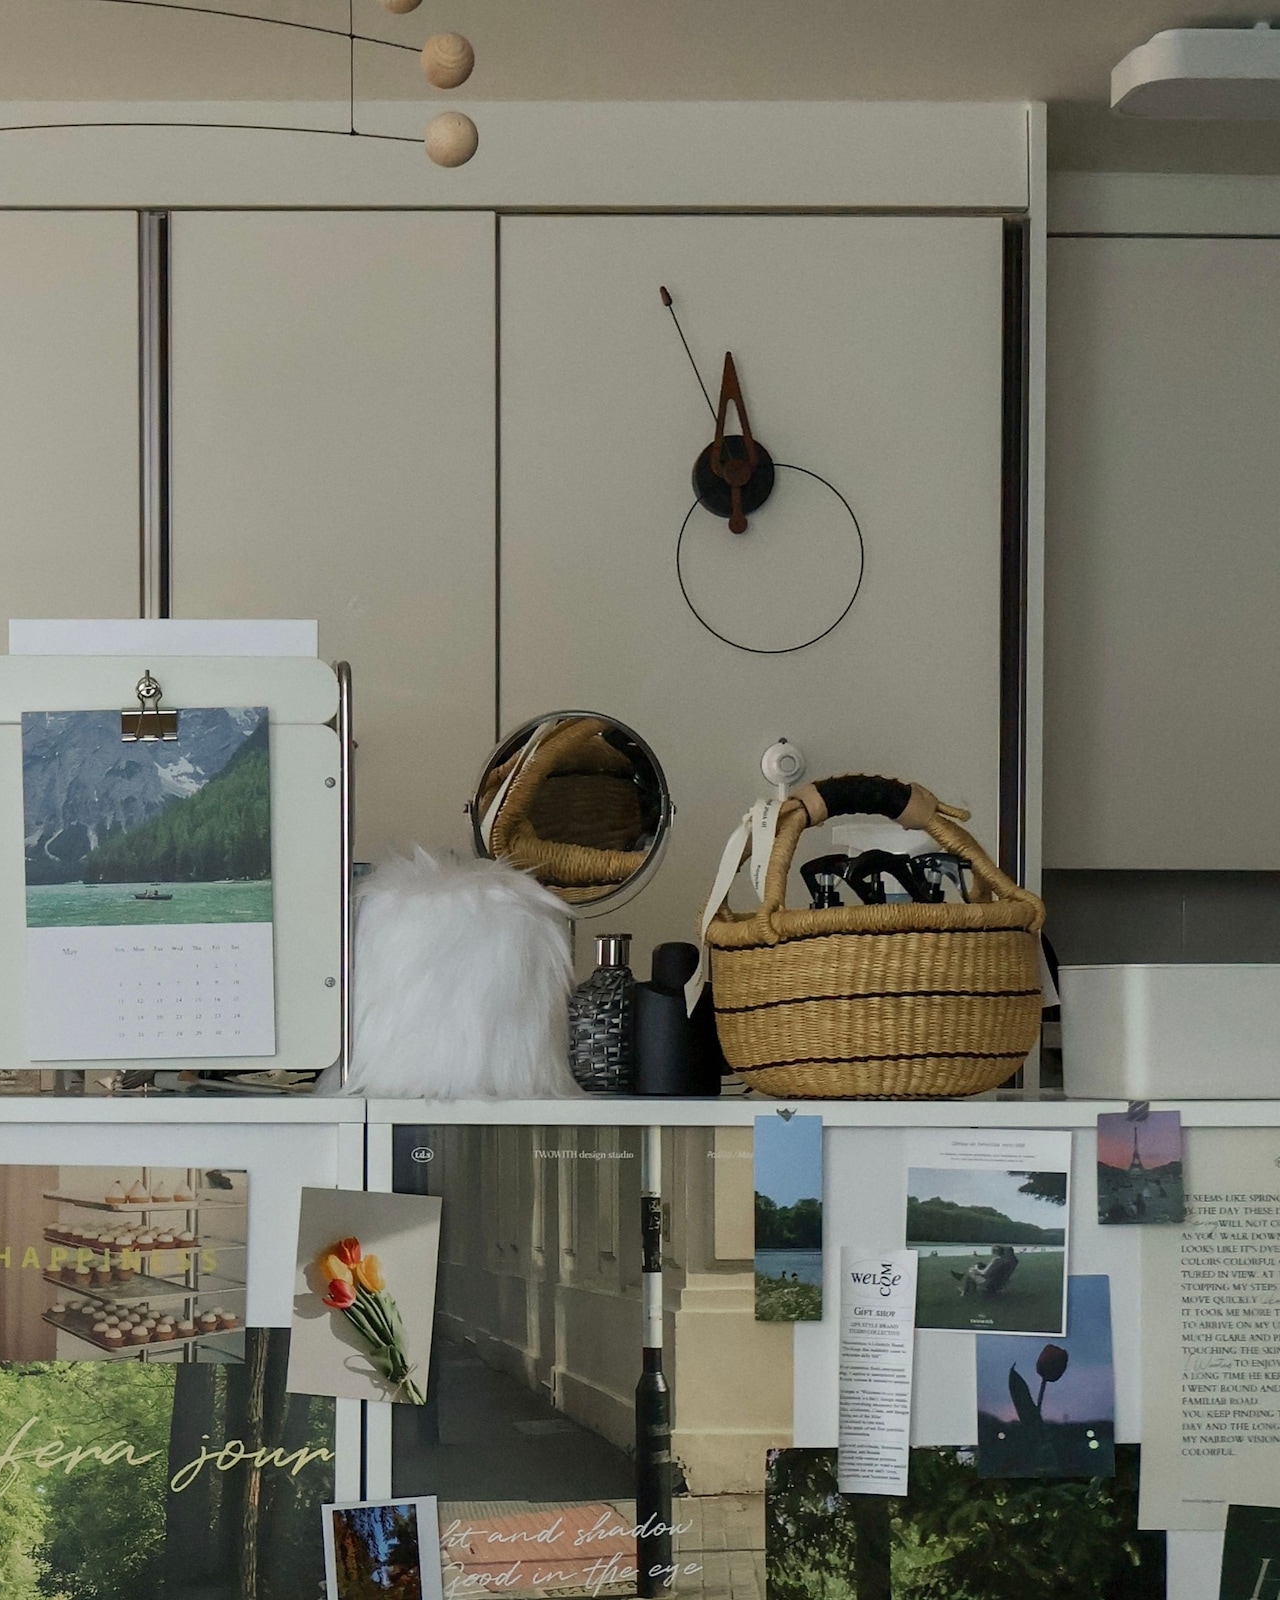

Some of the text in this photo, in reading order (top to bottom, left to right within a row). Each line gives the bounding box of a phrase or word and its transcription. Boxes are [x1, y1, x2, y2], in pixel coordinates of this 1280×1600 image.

[533, 1150, 578, 1159] TWOWITH
[579, 1150, 607, 1161] design
[607, 1150, 634, 1159] studio
[1193, 1194, 1223, 1202] SEEMS
[1225, 1194, 1246, 1202] LIKE
[1198, 1207, 1273, 1215] THE DAY THESE
[1218, 1219, 1242, 1228] WILL
[1245, 1219, 1268, 1228] NOT
[1181, 1232, 1192, 1241] AS
[1219, 1232, 1248, 1241] WALK
[1181, 1245, 1214, 1253] LOOKS
[1217, 1245, 1237, 1253] LIKE
[1181, 1257, 1275, 1266] COLORS COLORFUL
[1181, 1270, 1216, 1278] TURED
[1217, 1270, 1228, 1278] IN
[1261, 1270, 1274, 1278] AT
[1181, 1283, 1277, 1291] STOPPING MY STEPS
[1182, 1295, 1258, 1304] MOVE QUICKLY
[1181, 1308, 1276, 1316] IT TOOK ME MORE
[1182, 1321, 1197, 1329] TO
[1236, 1321, 1252, 1329] ON
[1255, 1321, 1270, 1329] MY
[1182, 1333, 1271, 1341] MUCH GLARE AND
[1182, 1346, 1237, 1354] TOUCHING
[1240, 1346, 1259, 1354] THE
[1235, 1359, 1249, 1368] TO
[1191, 1371, 1219, 1380] LONG
[1222, 1371, 1246, 1380] TIME
[1249, 1371, 1262, 1380] HE
[1187, 1384, 1217, 1392] WENT
[1182, 1397, 1227, 1405] FAMILIAR
[1182, 1410, 1274, 1418] YOU KEEP FINDING
[1182, 1423, 1202, 1431] DAY
[1205, 1423, 1227, 1431] AND
[1229, 1423, 1249, 1431] THE
[1182, 1435, 1197, 1443] MY
[487, 1517, 565, 1546] and
[573, 1511, 693, 1547] shadow
[532, 1566, 577, 1583] in
[582, 1552, 640, 1598] the
[648, 1558, 703, 1588] eye
